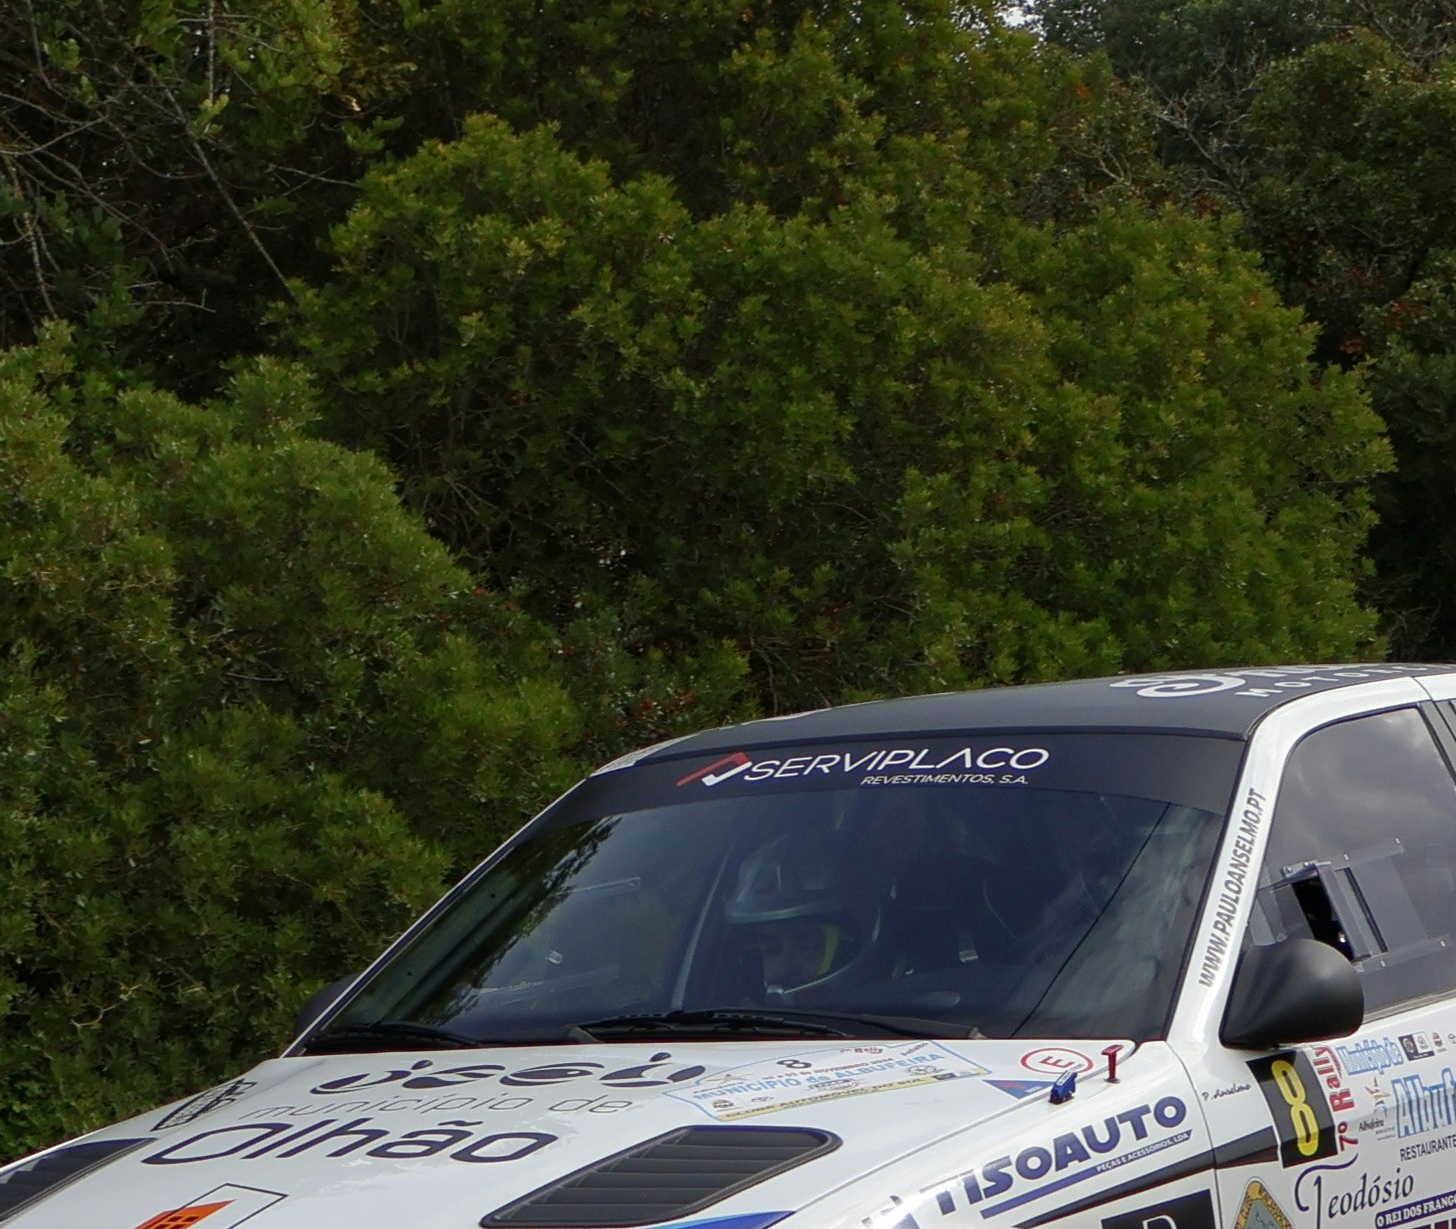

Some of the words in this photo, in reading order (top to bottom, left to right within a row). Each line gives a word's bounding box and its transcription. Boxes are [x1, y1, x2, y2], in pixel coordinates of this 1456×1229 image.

[744, 748, 1050, 781] SERVIPLACO
[861, 773, 995, 786] REVESTIMENTOS,
[1000, 774, 1029, 786] S.A.
[1199, 788, 1266, 988] WWW.PAULOANSELMO.PT
[693, 1078, 802, 1100] MUNICÍPIO
[805, 1074, 832, 1084] de
[834, 1054, 945, 1079] ALBUFEIRA
[776, 1059, 813, 1069] 8
[1039, 1056, 1076, 1068] E
[1313, 1045, 1355, 1112] Rally
[239, 1092, 534, 1119] município
[549, 1095, 633, 1115] de
[1270, 1059, 1320, 1156] 8
[141, 1118, 559, 1165] Olhão
[919, 1095, 1187, 1216] TISOAUTO
[1376, 1214, 1384, 1227] O
[1385, 1210, 1403, 1225] REI
[1404, 1204, 1422, 1220] DOS
